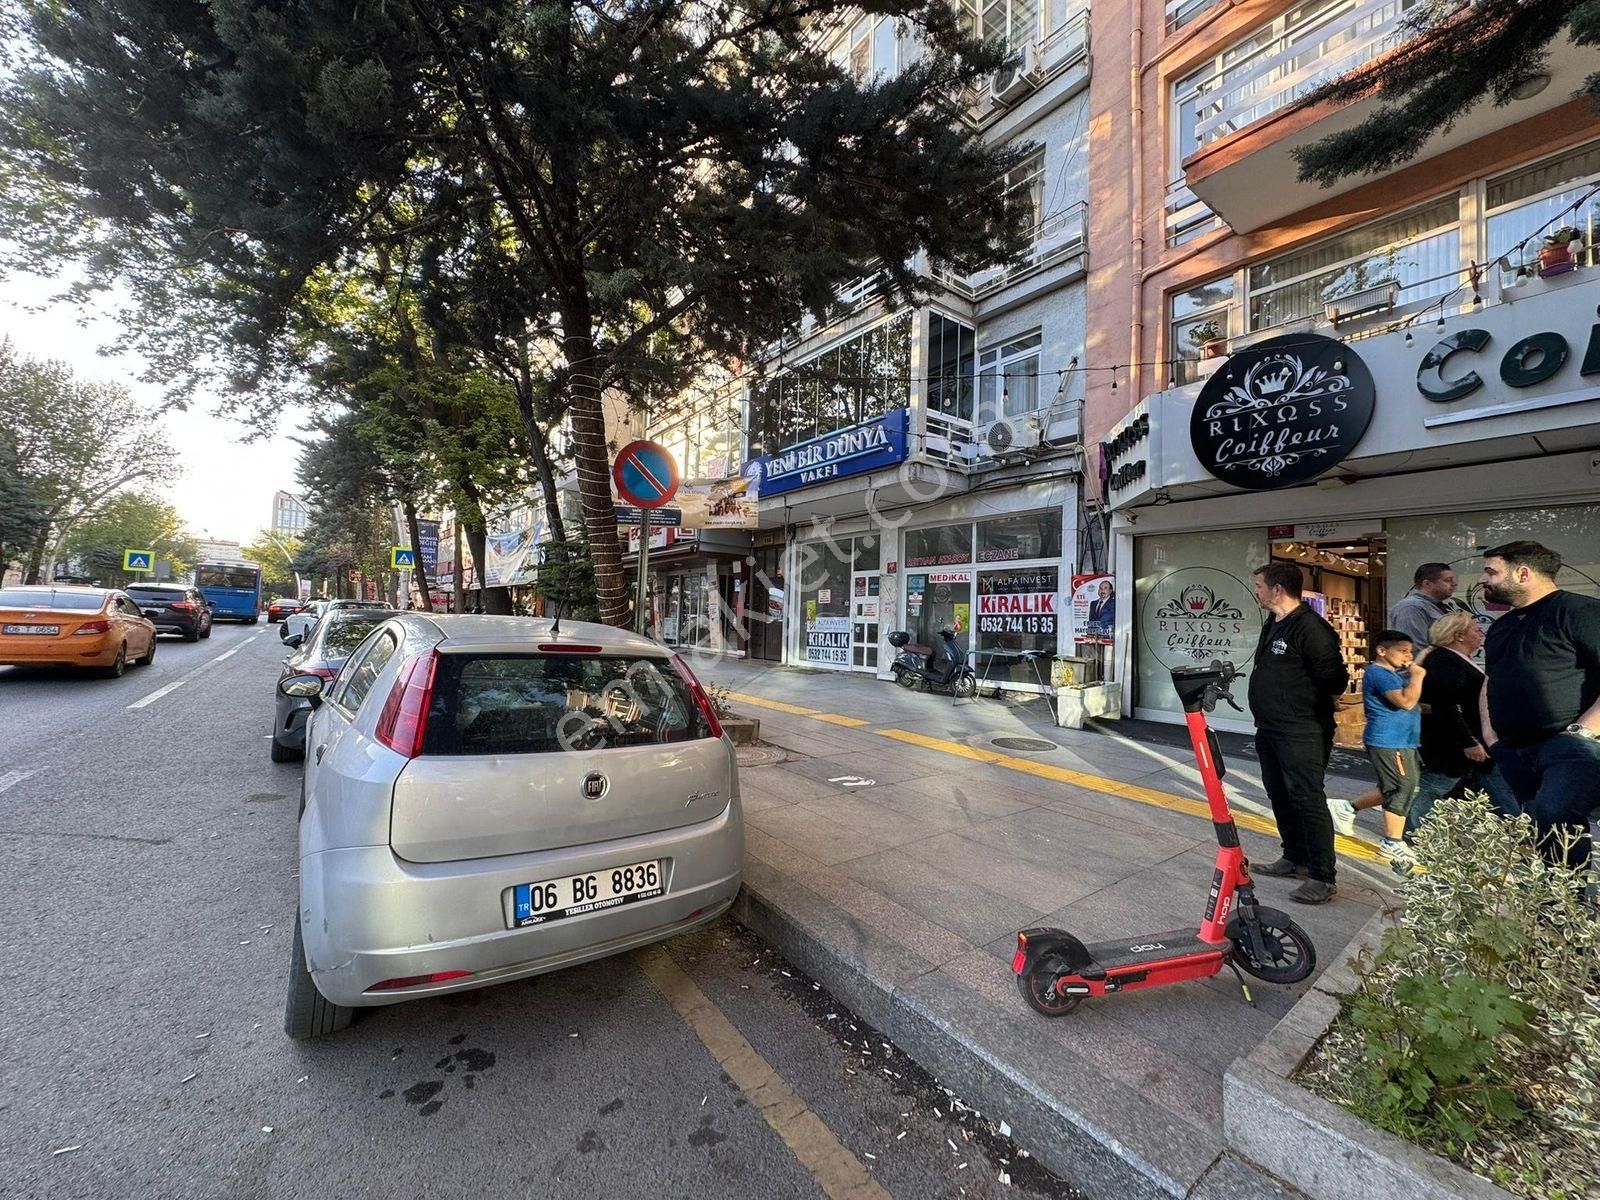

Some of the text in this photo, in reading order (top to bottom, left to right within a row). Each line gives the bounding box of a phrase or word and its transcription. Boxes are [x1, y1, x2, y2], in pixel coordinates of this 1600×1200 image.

[764, 424, 889, 477] YENİ BİR DÜNYA
[1215, 424, 1340, 463] Coiffeur
[978, 548, 1019, 562] ECZANE
[998, 575, 1052, 586] ALFA INVEST
[981, 617, 1054, 633] 0532 744 15 35
[1167, 634, 1232, 647] Coiffeur
[808, 649, 847, 662] 0532 744 15 35
[588, 780, 603, 793] FIAT
[518, 863, 657, 912] TR 06 BG 8836
[1217, 896, 1231, 925] hop
